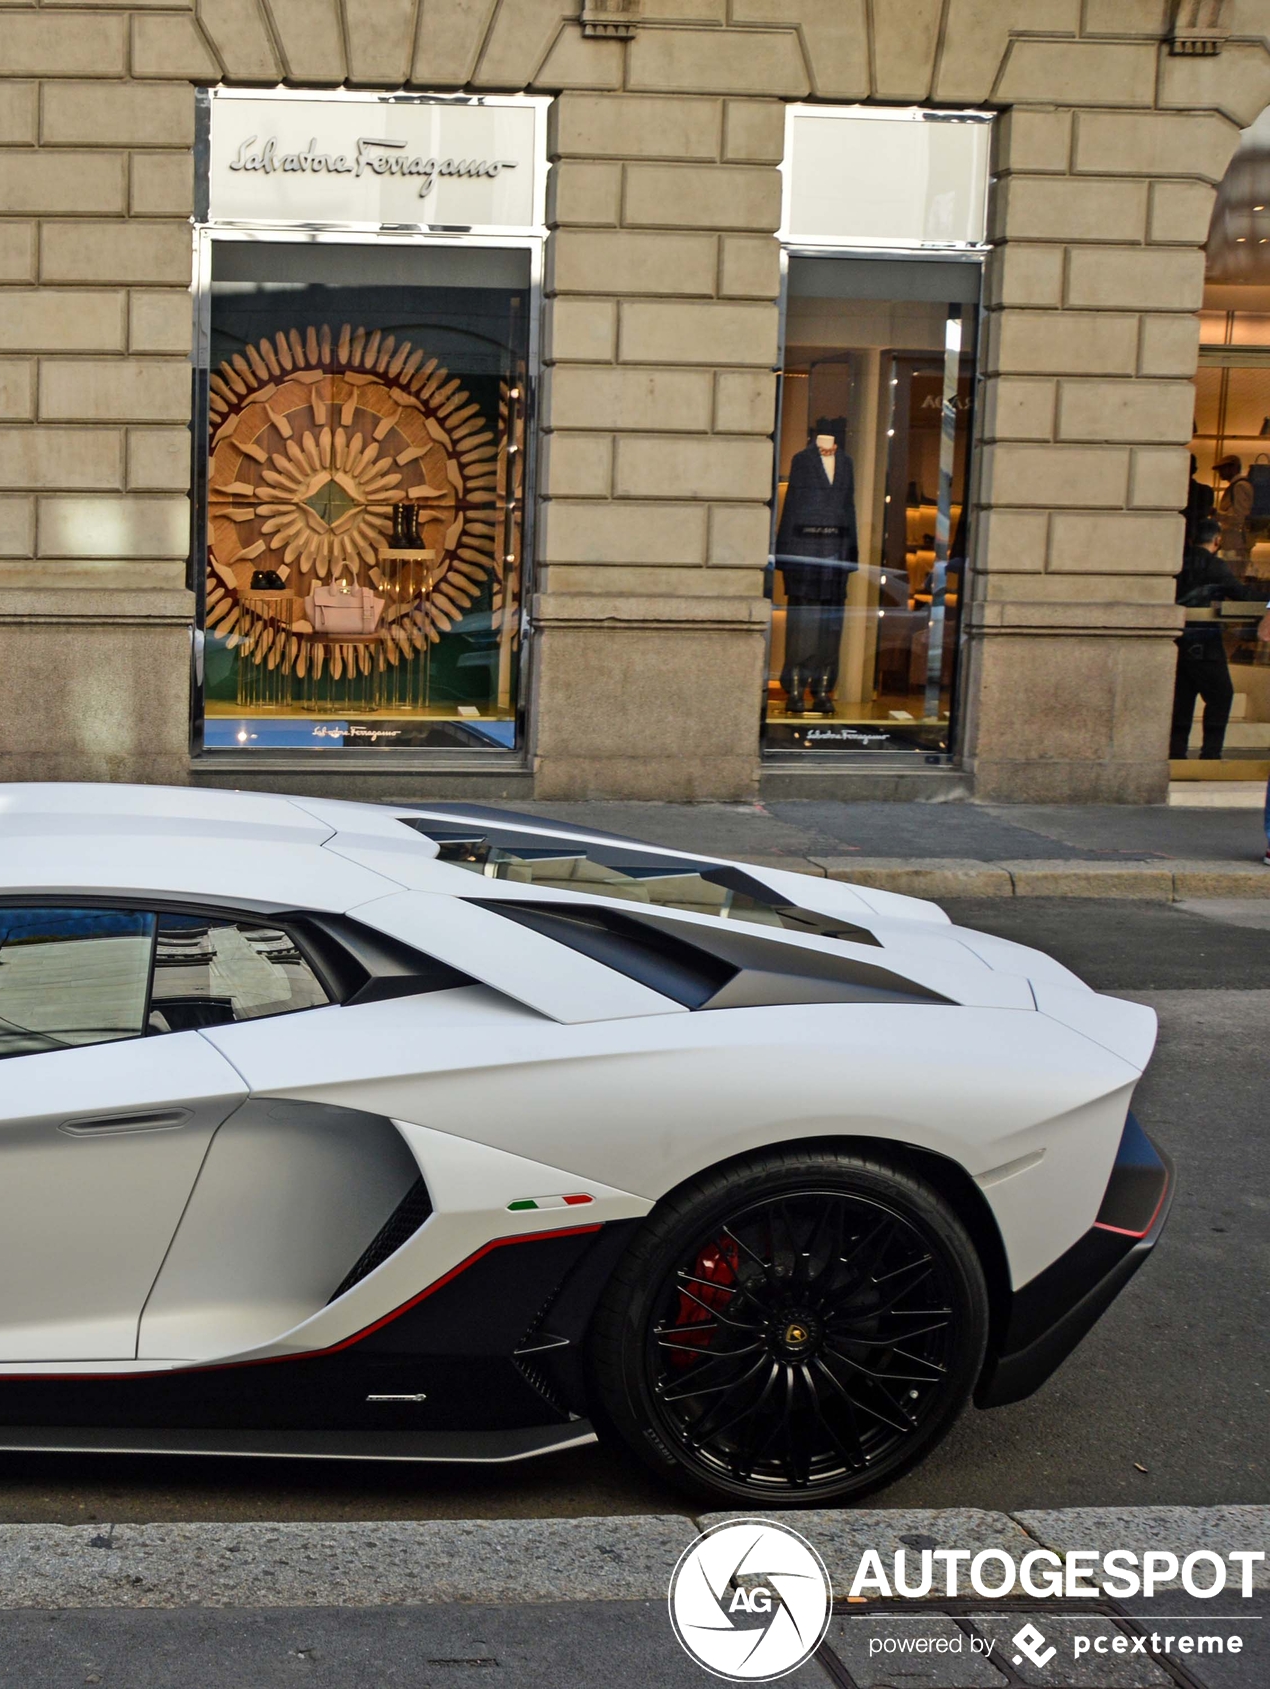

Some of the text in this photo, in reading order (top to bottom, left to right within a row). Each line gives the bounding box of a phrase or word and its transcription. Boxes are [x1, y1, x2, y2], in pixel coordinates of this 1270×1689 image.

[230, 135, 519, 198] Salvatore Ferragamo
[312, 726, 401, 741] Salvatore Ferragamo
